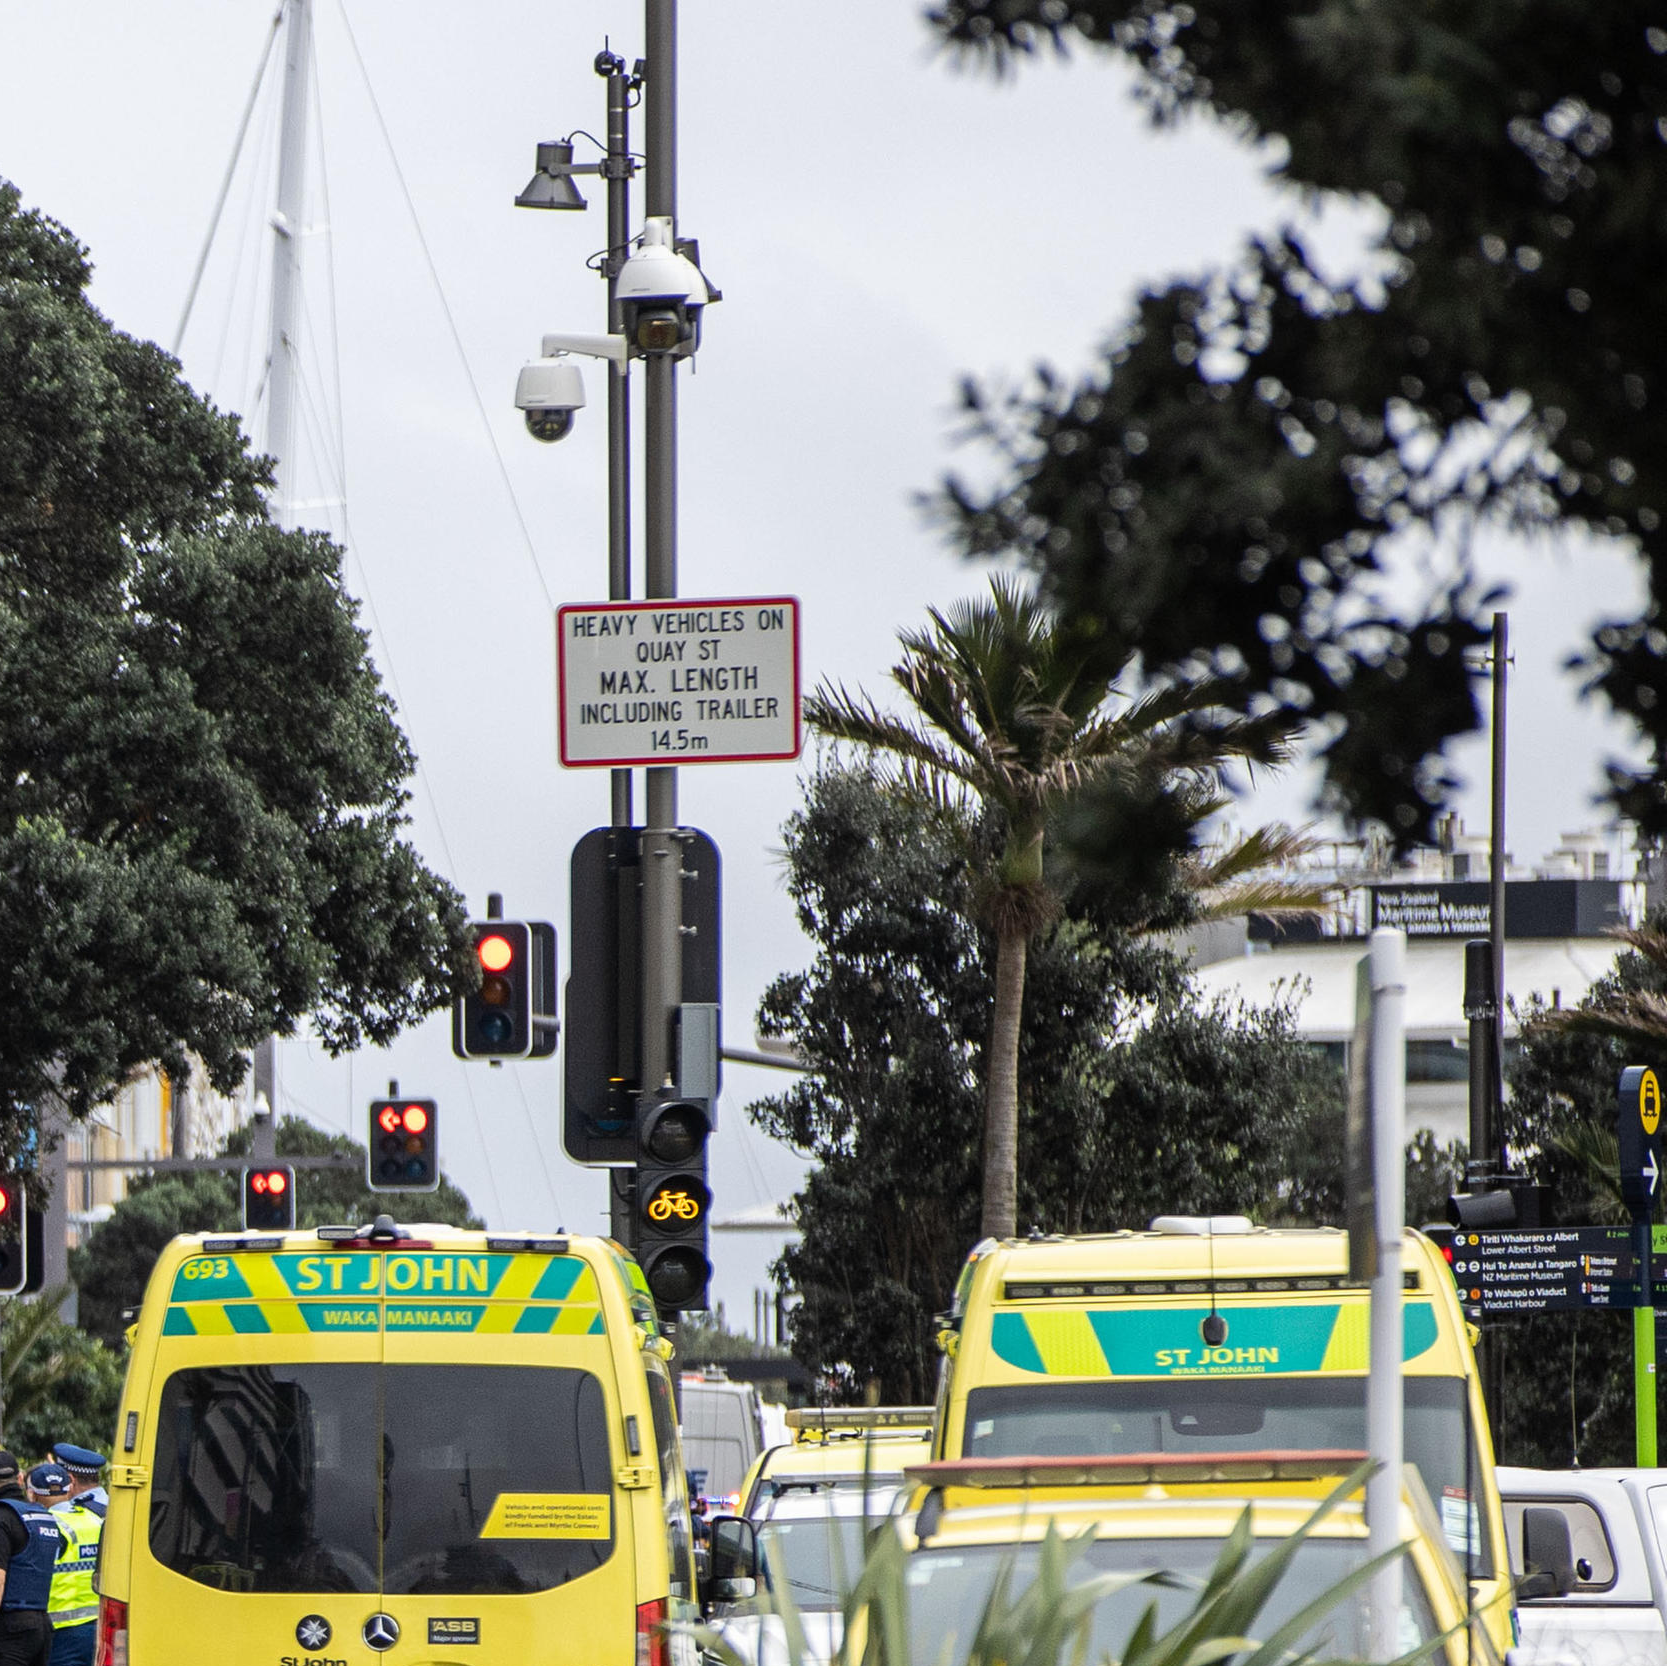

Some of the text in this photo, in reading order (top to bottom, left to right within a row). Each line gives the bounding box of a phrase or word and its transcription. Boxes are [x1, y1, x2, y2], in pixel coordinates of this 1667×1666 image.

[574, 609, 784, 637] HEAVY VEHICLES ON
[636, 639, 721, 663] QUAY ST
[600, 666, 758, 695] MAX. LENGTH
[580, 697, 779, 724] INCLUDING TRAILER
[651, 729, 709, 751] 14.5m
[1378, 906, 1439, 920] Maritime
[1554, 1232, 1579, 1242] Albert
[1482, 1244, 1556, 1255] Lower Albert Street
[182, 1259, 229, 1280] 693
[1482, 1262, 1497, 1271] Hui
[1498, 1261, 1508, 1270] Te
[296, 1257, 489, 1292] ST JOHN
[1482, 1271, 1564, 1282] NZ Maritime Museum
[1483, 1290, 1493, 1298] Te
[1536, 1287, 1567, 1296] Viaduct
[1483, 1298, 1547, 1309] Viaduct Harbour
[323, 1309, 472, 1326] WAKA MANAAKI
[1155, 1347, 1279, 1366] ST JOHN
[39, 1526, 59, 1538] POLICE
[432, 1621, 476, 1633] ASB
